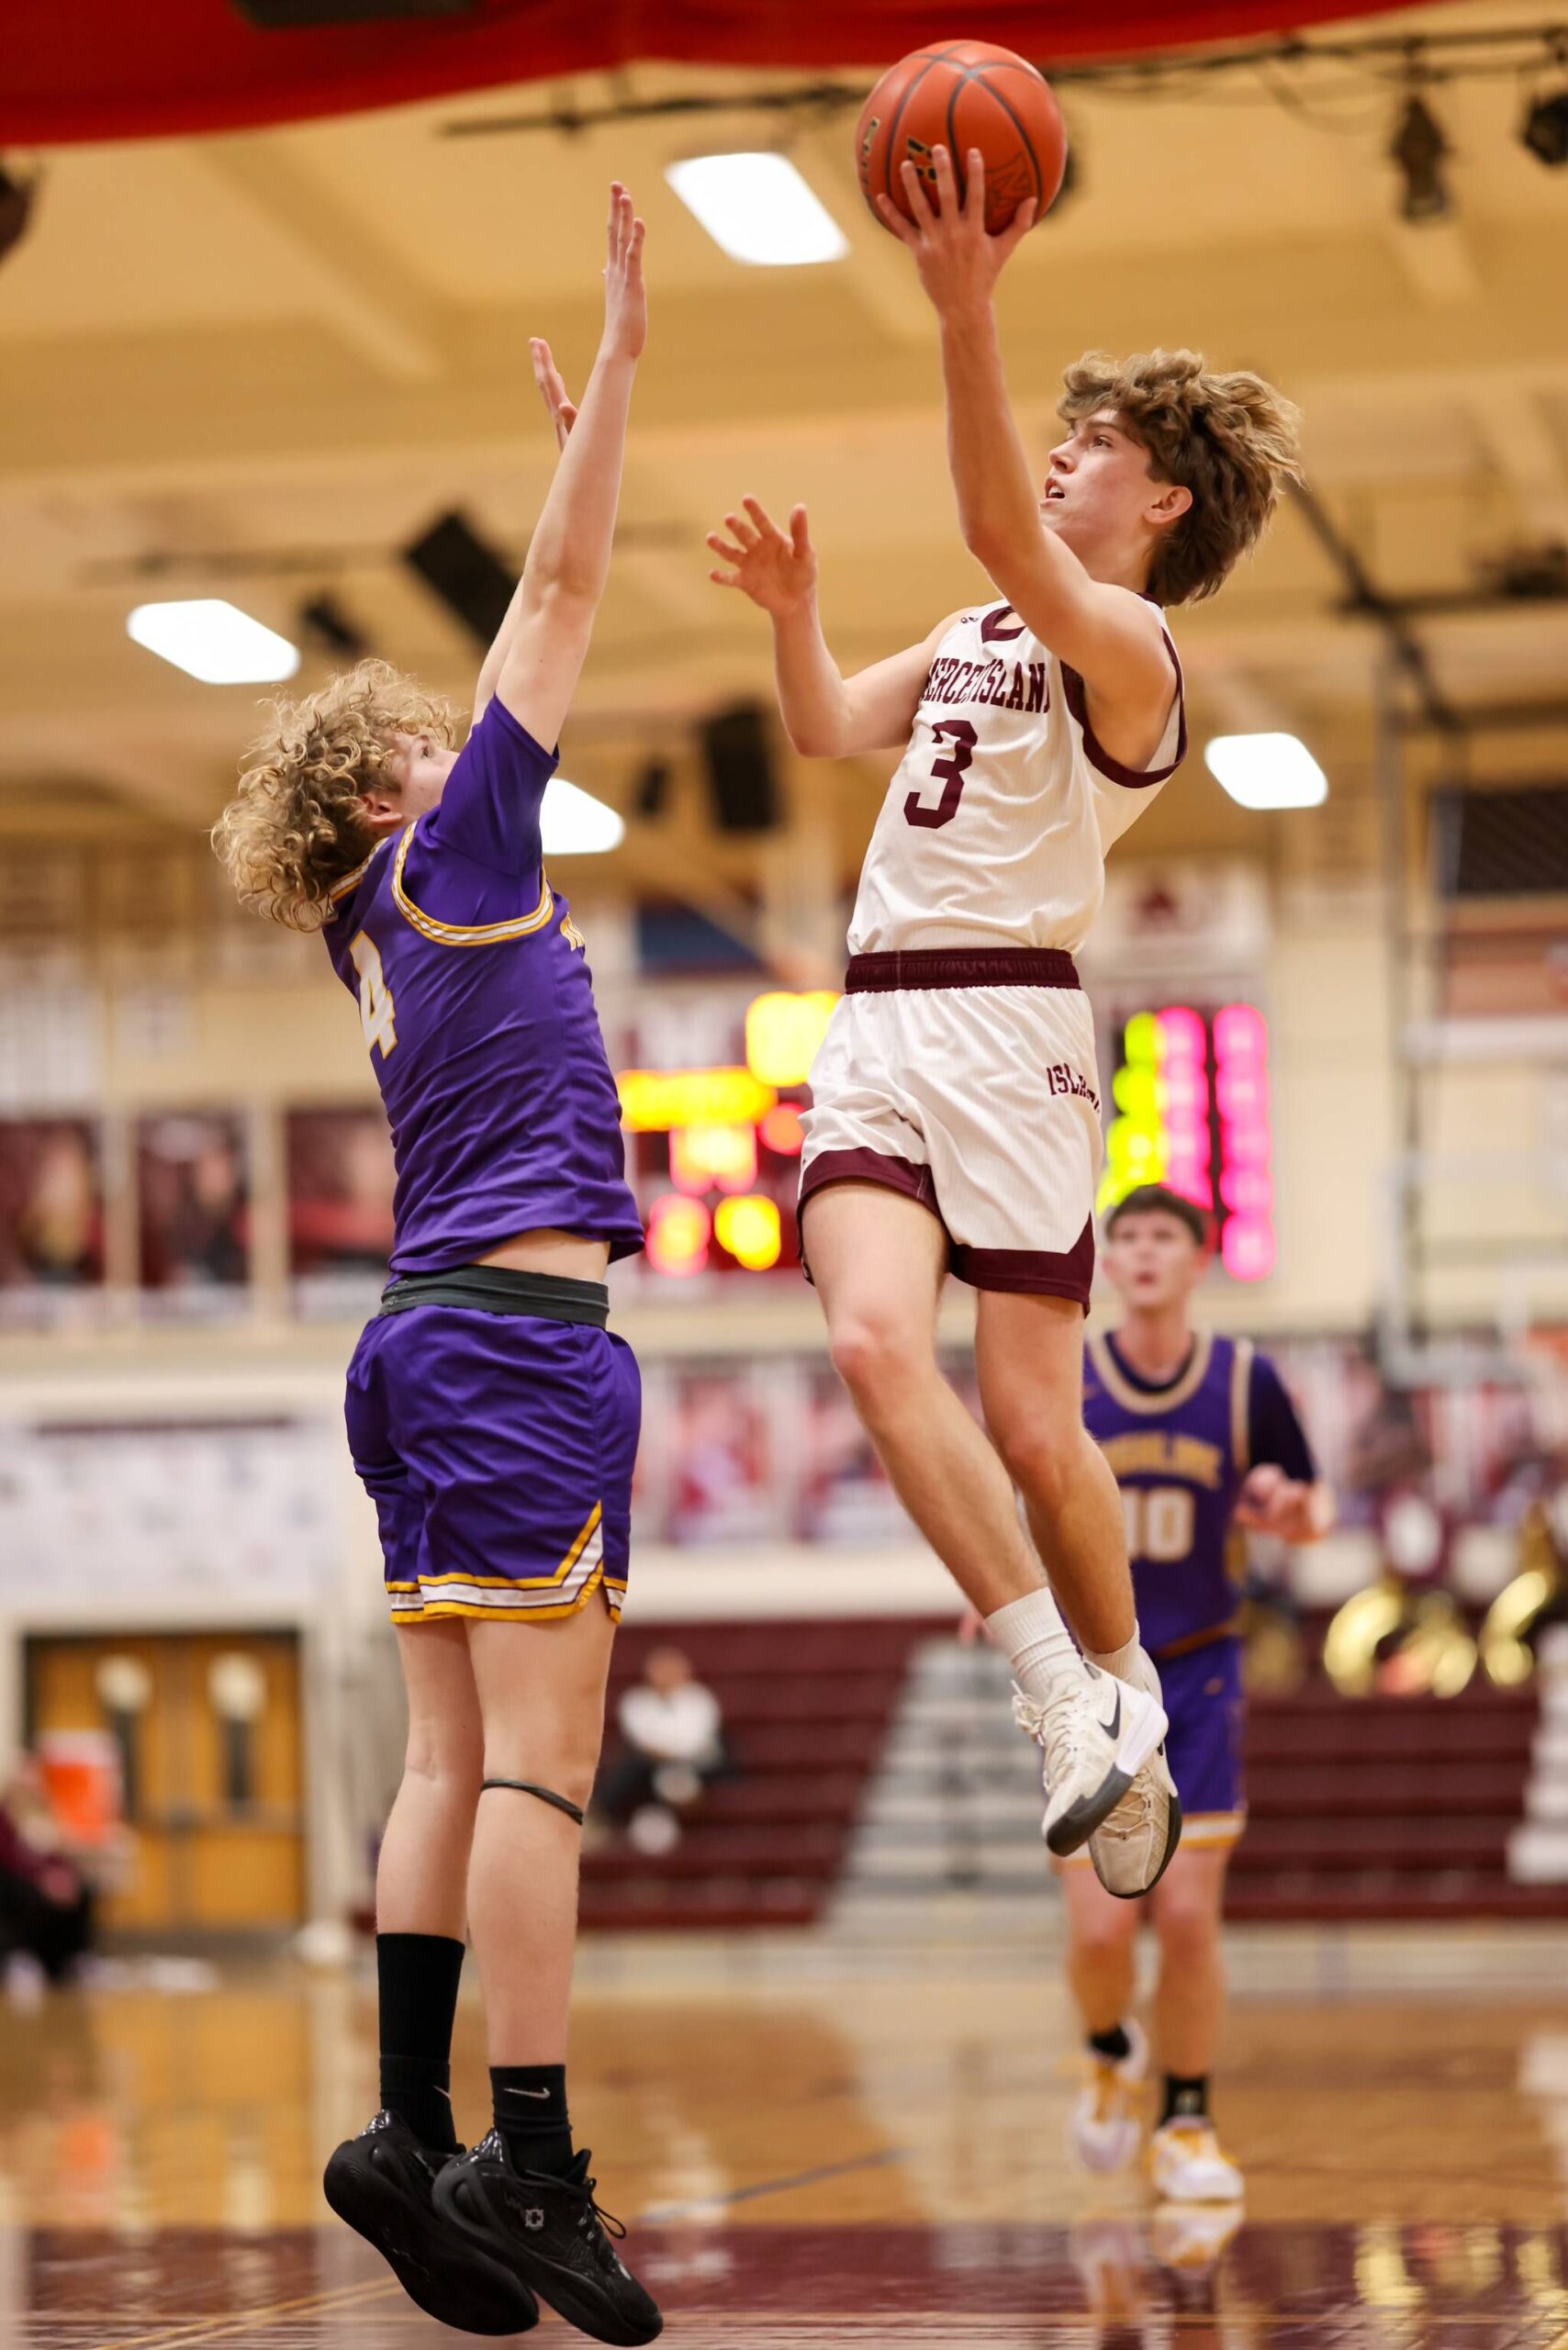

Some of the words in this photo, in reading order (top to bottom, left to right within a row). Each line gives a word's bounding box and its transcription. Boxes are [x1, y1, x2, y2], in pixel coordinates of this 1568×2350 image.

[971, 658, 1050, 713] ISLAN
[903, 720, 978, 829] 3
[350, 929, 398, 1059] 4
